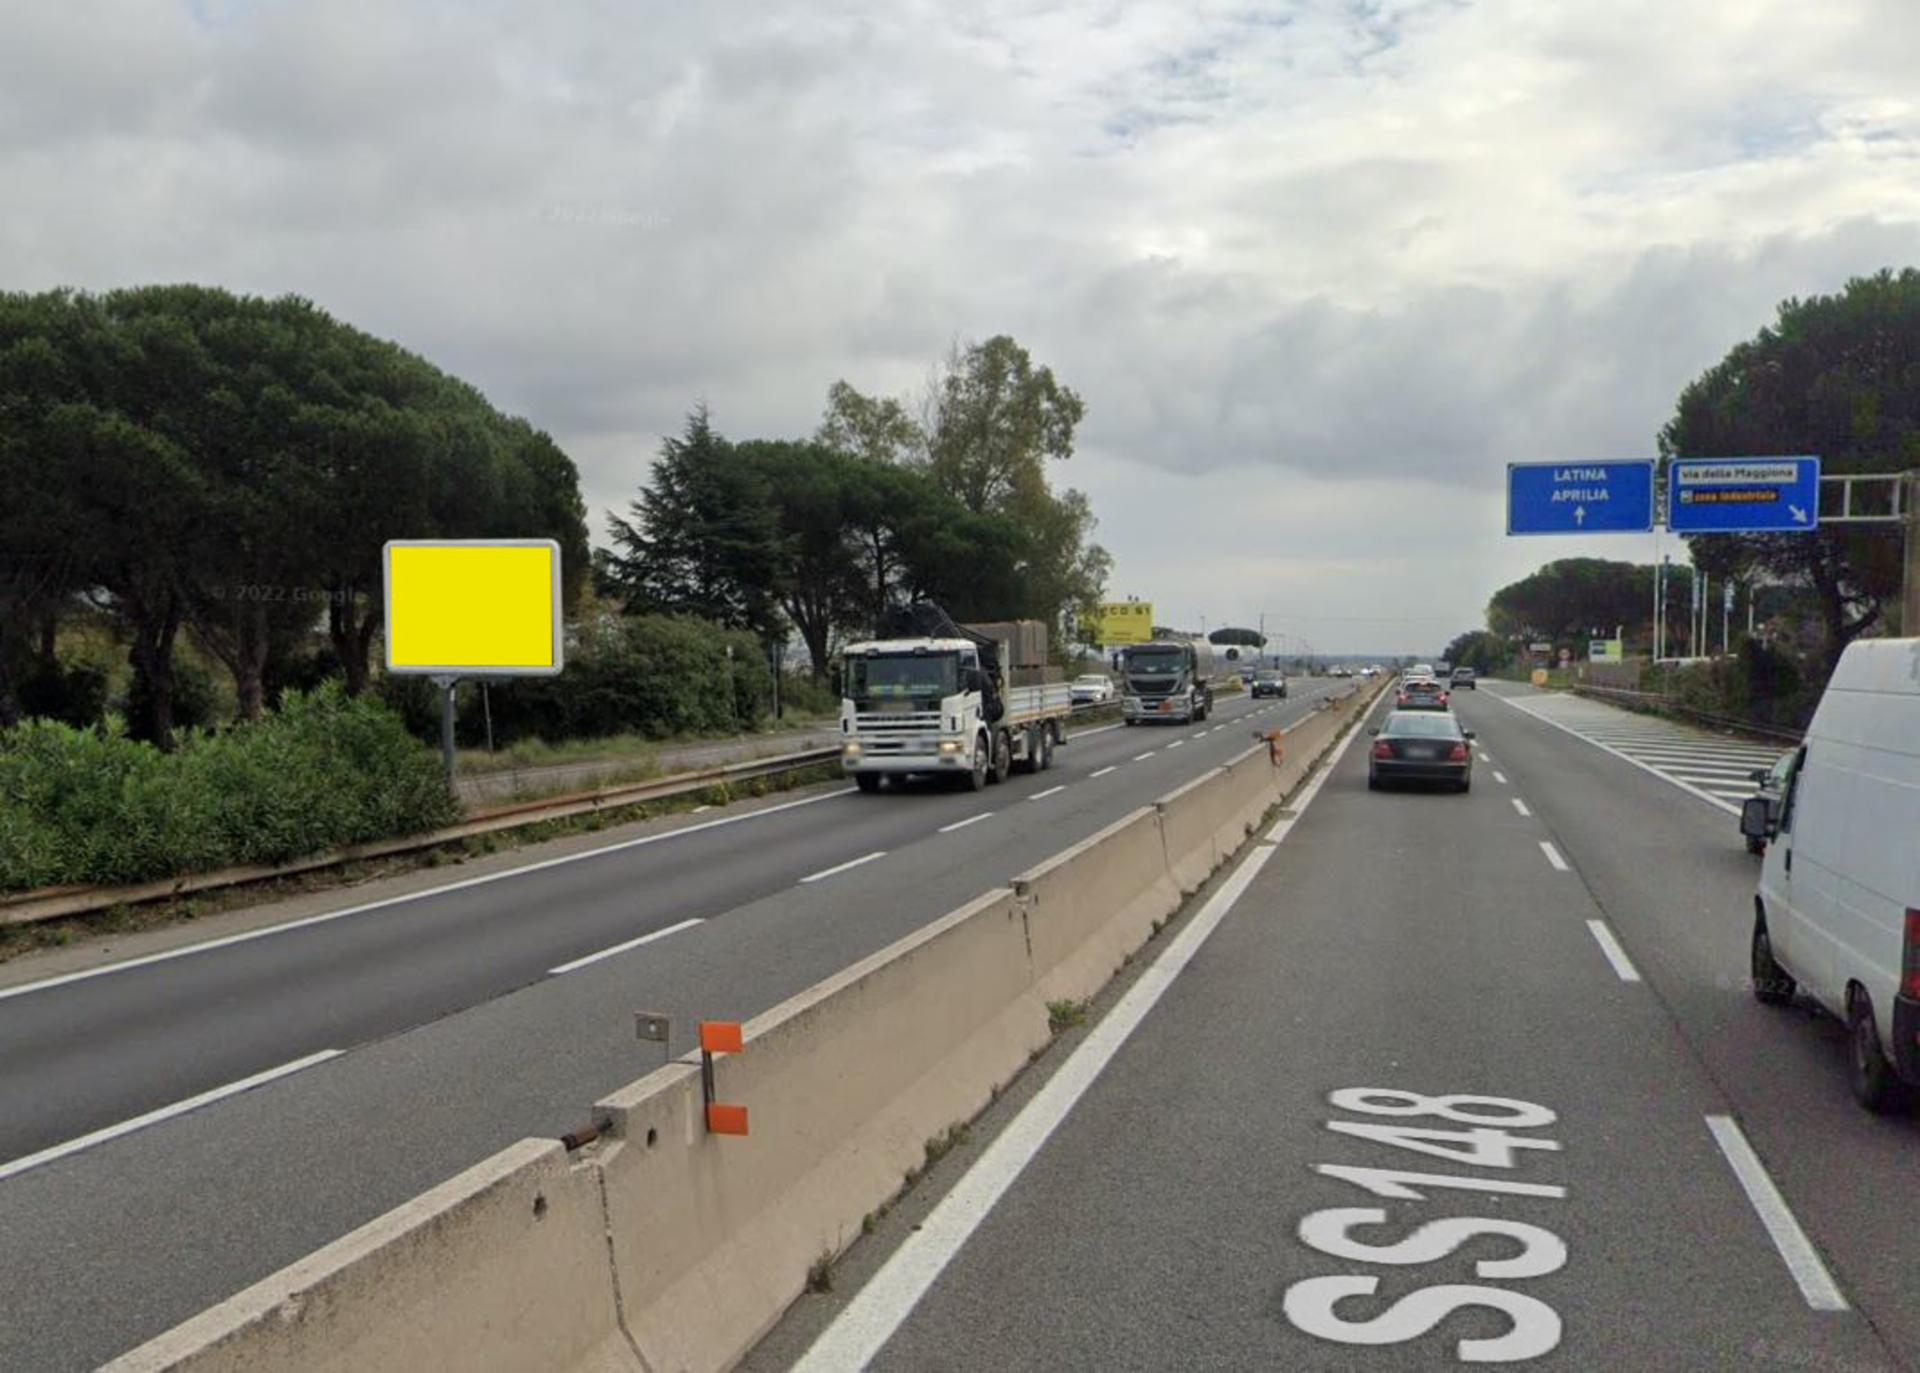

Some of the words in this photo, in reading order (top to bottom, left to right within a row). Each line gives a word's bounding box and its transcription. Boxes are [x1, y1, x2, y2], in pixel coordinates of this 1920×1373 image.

[1553, 468, 1607, 482] LATINA
[1702, 468, 1732, 479] della
[1551, 488, 1609, 502] APRILIA
[1282, 1086, 1568, 1363] SS148
